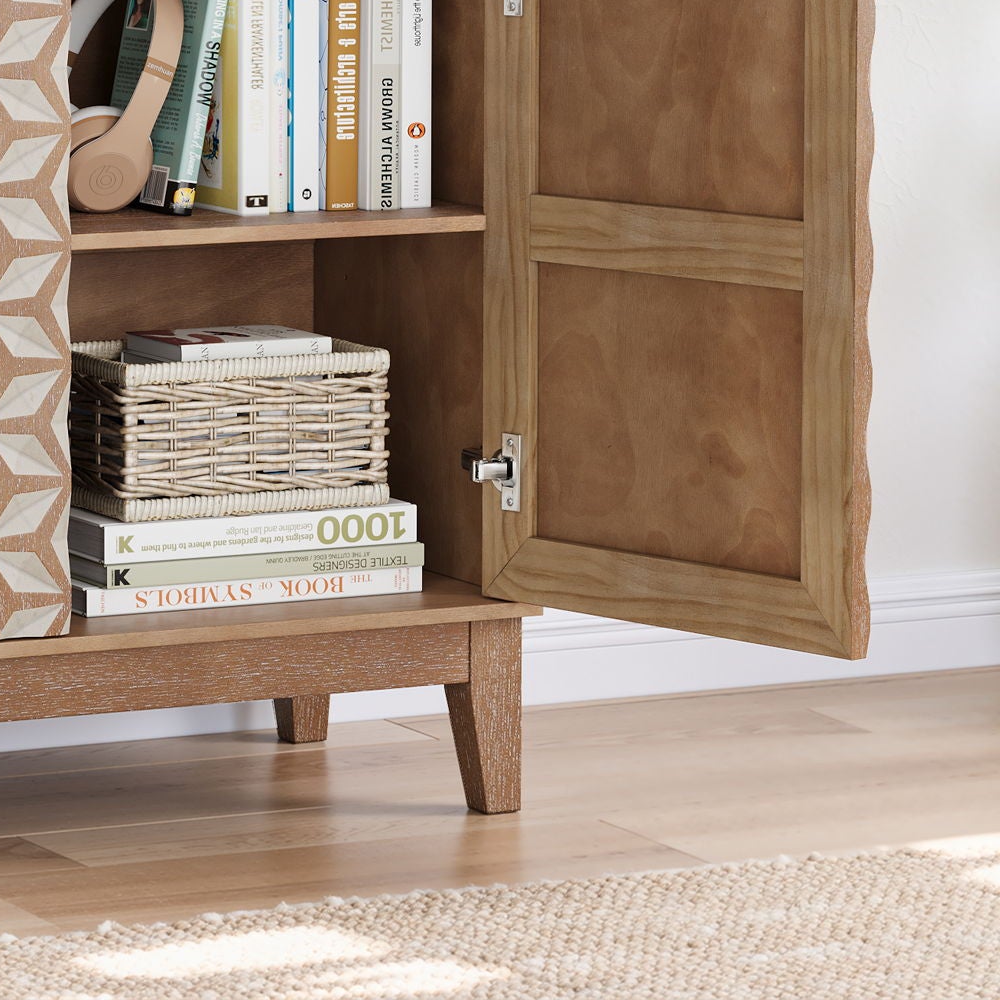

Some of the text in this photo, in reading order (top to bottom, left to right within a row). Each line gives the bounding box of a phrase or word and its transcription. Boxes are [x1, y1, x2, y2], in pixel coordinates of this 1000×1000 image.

[212, 18, 225, 30] IN
[210, 31, 220, 39] A
[196, 40, 221, 108] SHADOW
[226, 526, 248, 537] Rudge
[263, 525, 277, 535] and
[279, 523, 313, 534] Geraldine
[317, 511, 406, 544] 1000
[229, 536, 258, 548] gardens
[260, 537, 272, 545] the
[274, 536, 284, 544] for
[286, 533, 314, 543] designs
[141, 544, 160, 553] them
[162, 543, 177, 552] find
[188, 541, 211, 550] where
[214, 540, 227, 549] and
[313, 556, 408, 571] TEXTILE DESIGNERS
[135, 574, 371, 608] THE BOOK OF SYMBOLS
